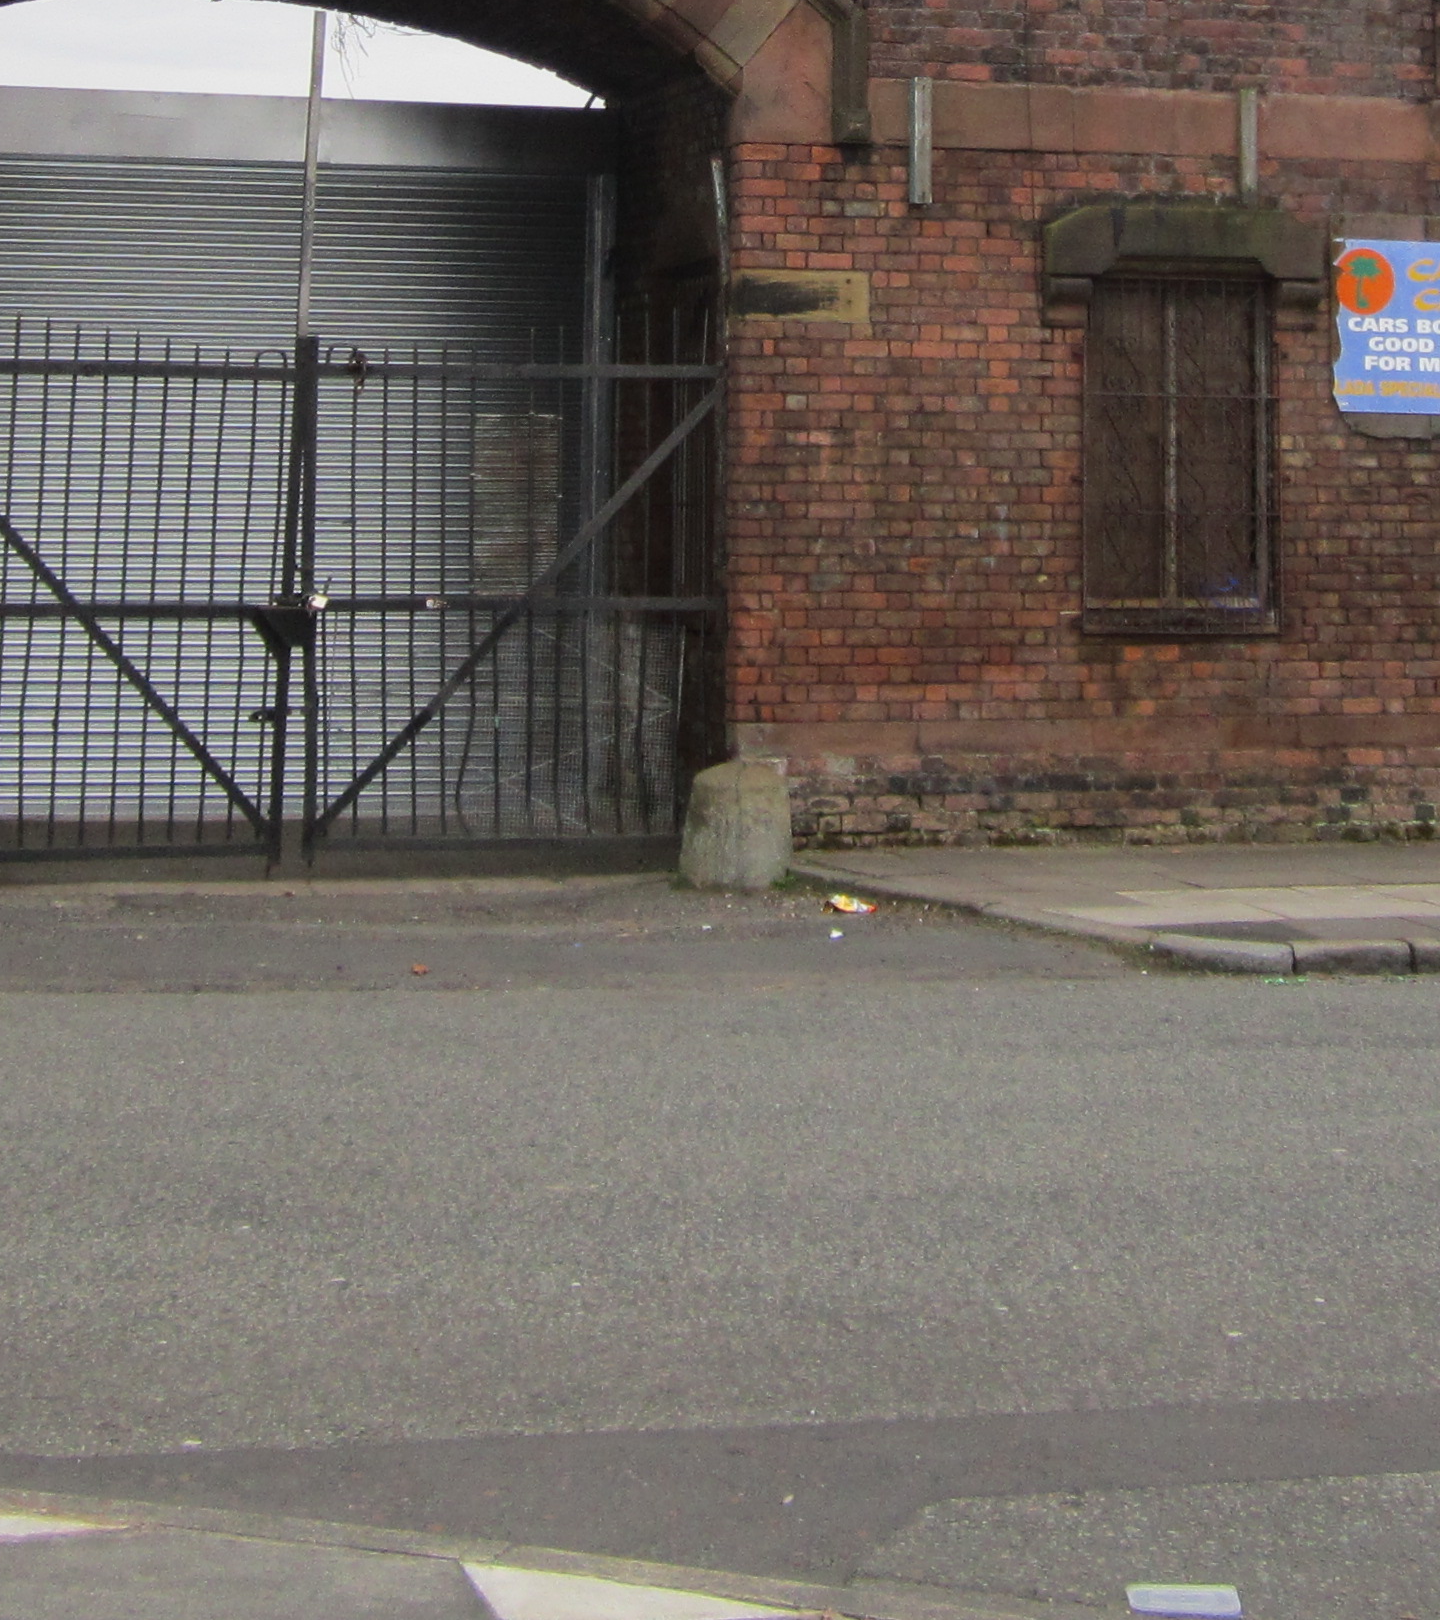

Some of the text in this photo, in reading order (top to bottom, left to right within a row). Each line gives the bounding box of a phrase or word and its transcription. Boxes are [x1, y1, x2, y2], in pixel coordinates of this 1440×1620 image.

[1348, 317, 1408, 333] CARS
[1369, 336, 1434, 353] GOOD
[1365, 355, 1411, 371] FOR
